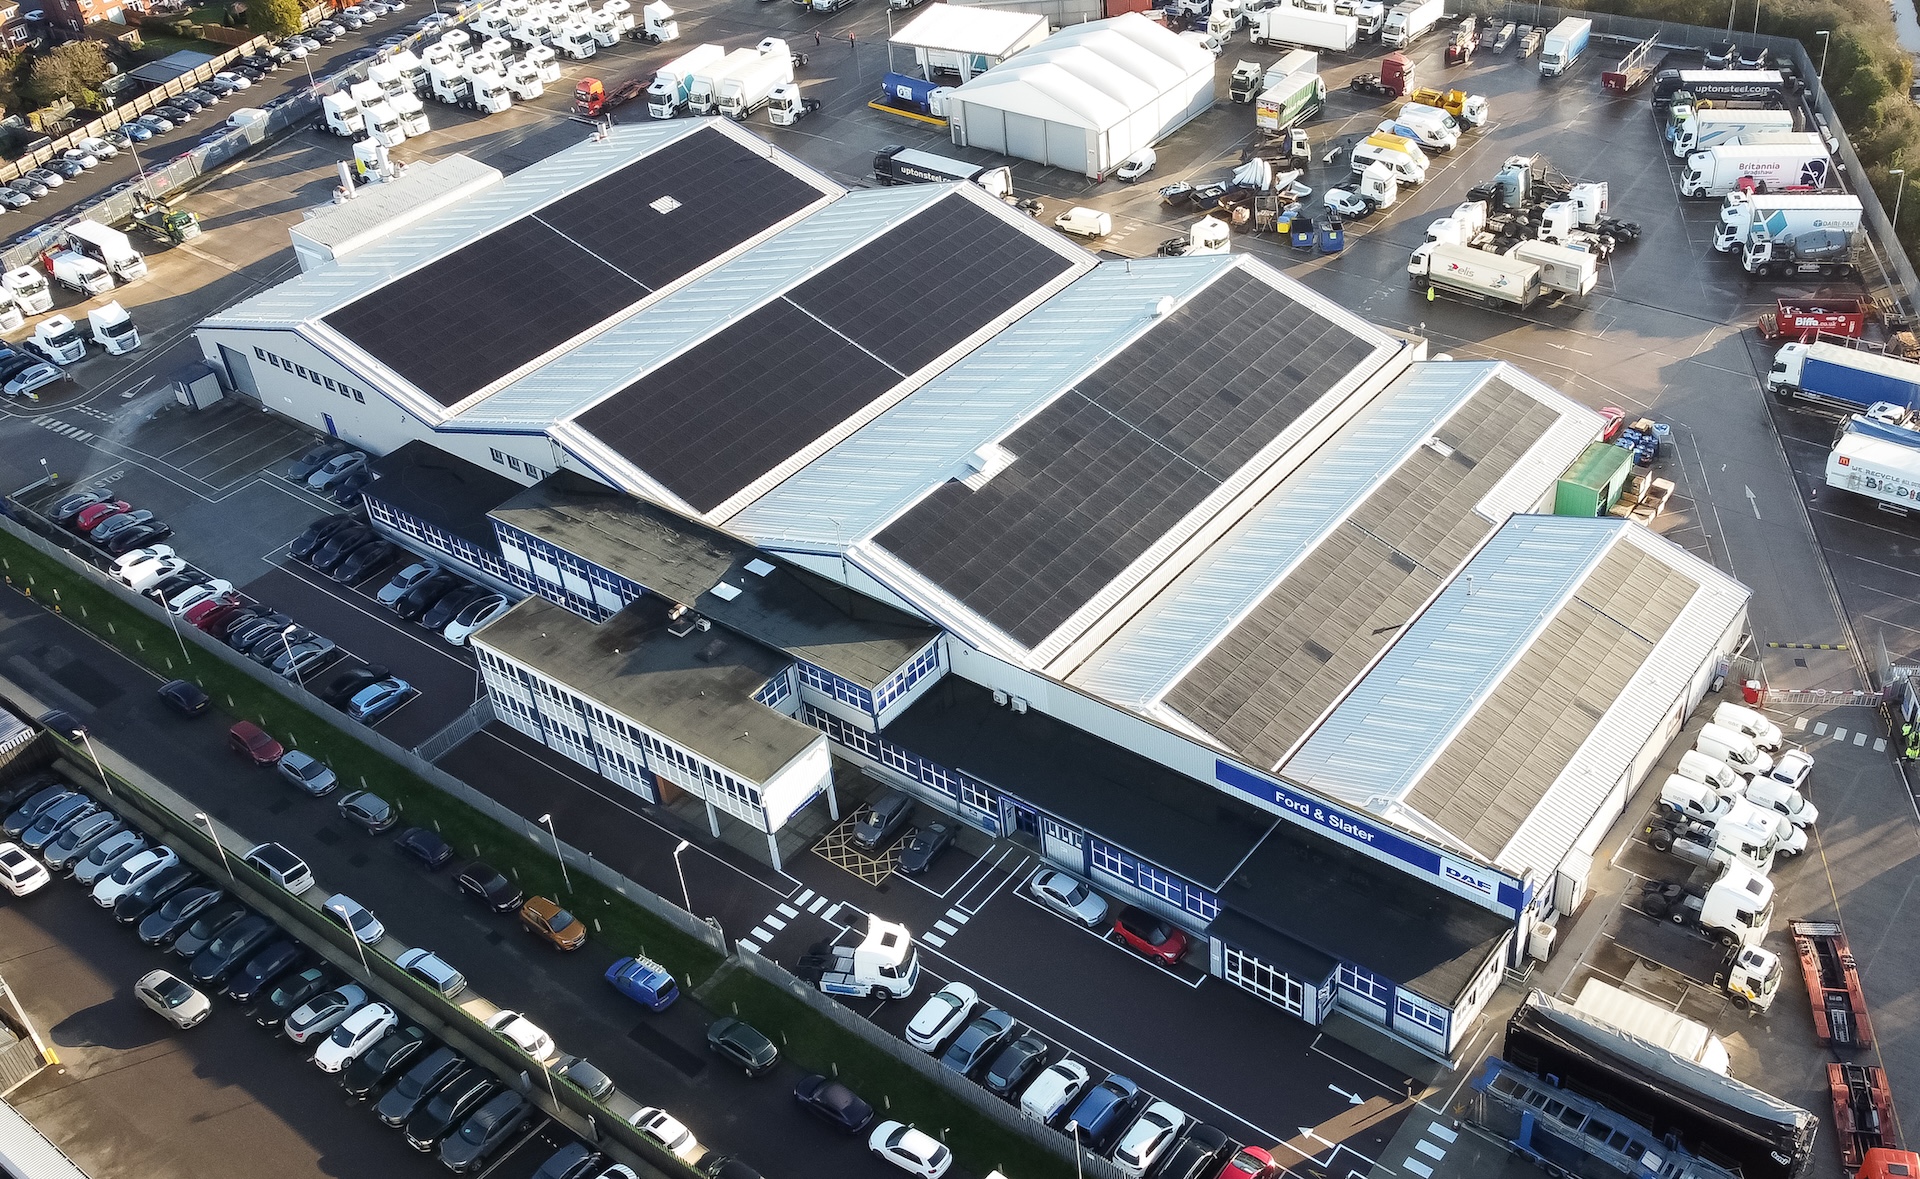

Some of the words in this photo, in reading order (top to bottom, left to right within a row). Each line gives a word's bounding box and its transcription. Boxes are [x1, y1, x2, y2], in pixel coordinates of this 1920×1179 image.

[1695, 84, 1770, 93] uptonsteel.com
[1739, 162, 1780, 170] Britannia
[1457, 267, 1474, 277] elis
[94, 470, 125, 487] STOP
[1851, 465, 1863, 473] WE
[1865, 468, 1901, 483] RECYCLE
[1275, 790, 1310, 816] Ford
[1313, 807, 1325, 822] &
[1328, 814, 1375, 842] Slater
[1446, 866, 1491, 890] DAF
